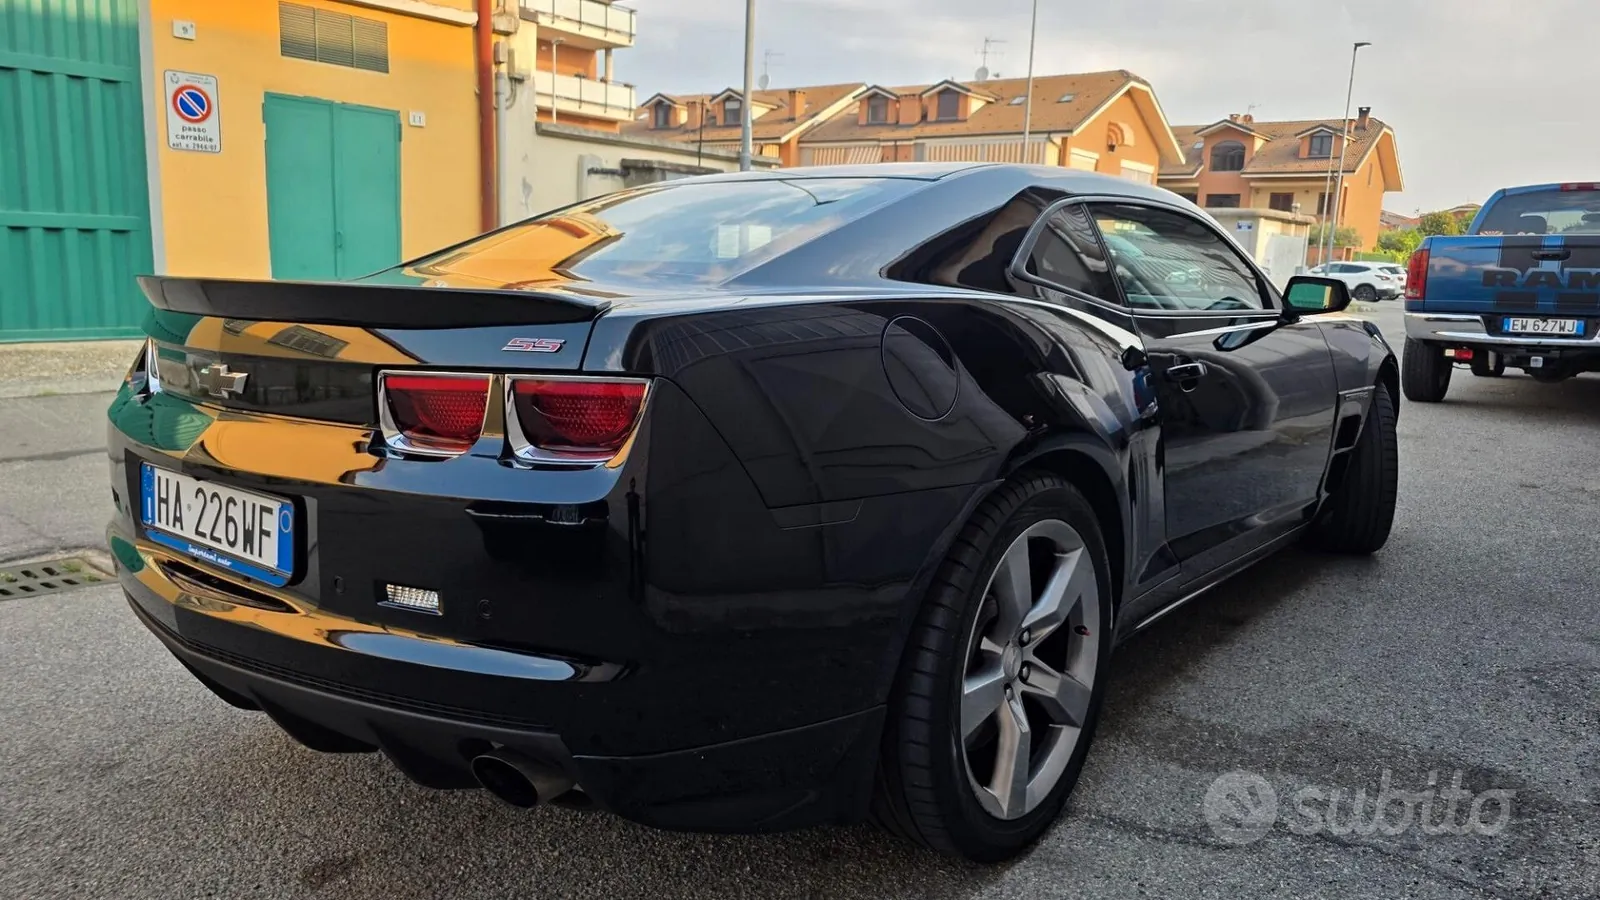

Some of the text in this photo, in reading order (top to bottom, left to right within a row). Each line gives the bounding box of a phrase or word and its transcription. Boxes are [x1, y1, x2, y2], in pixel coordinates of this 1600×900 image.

[182, 125, 207, 133] passo
[175, 134, 213, 142] carrabile
[1482, 269, 1600, 289] RAM
[1511, 319, 1576, 333] EW 627WJ
[501, 337, 566, 353] SS
[157, 475, 274, 558] HA 226WF
